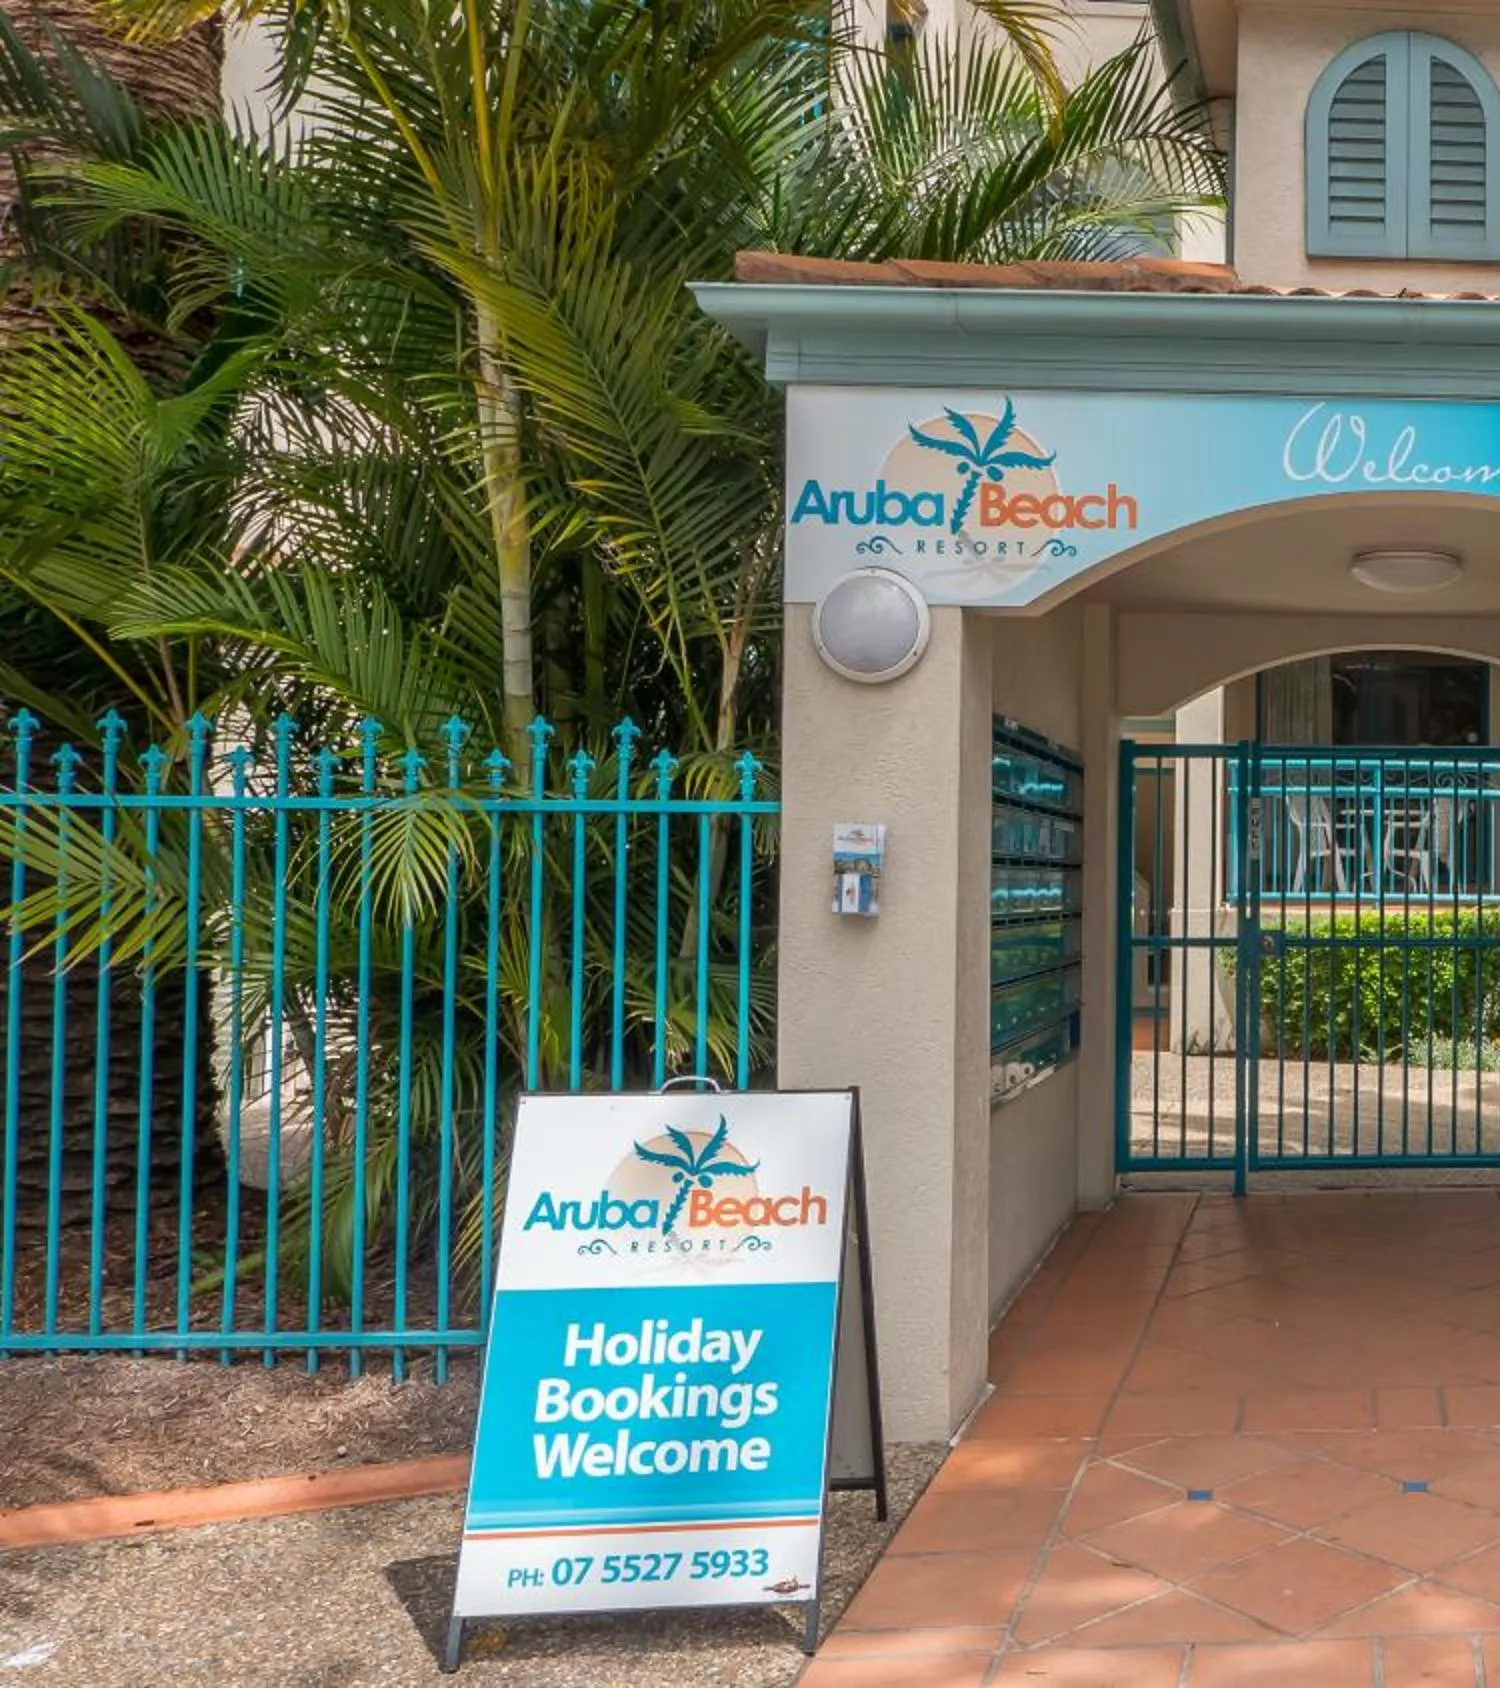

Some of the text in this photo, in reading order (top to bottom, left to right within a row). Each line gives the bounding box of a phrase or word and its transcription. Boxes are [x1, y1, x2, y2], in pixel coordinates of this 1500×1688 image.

[790, 479, 1138, 530] Aruba Beach
[916, 540, 1026, 556] RESORT
[522, 1186, 828, 1231] Aruba Beach
[630, 1239, 727, 1253] RESORT
[563, 1317, 764, 1375] Holiday
[534, 1371, 780, 1429] Bookings
[532, 1428, 772, 1480] Welcome
[507, 1547, 769, 1588] PH: 07 5527 5933
